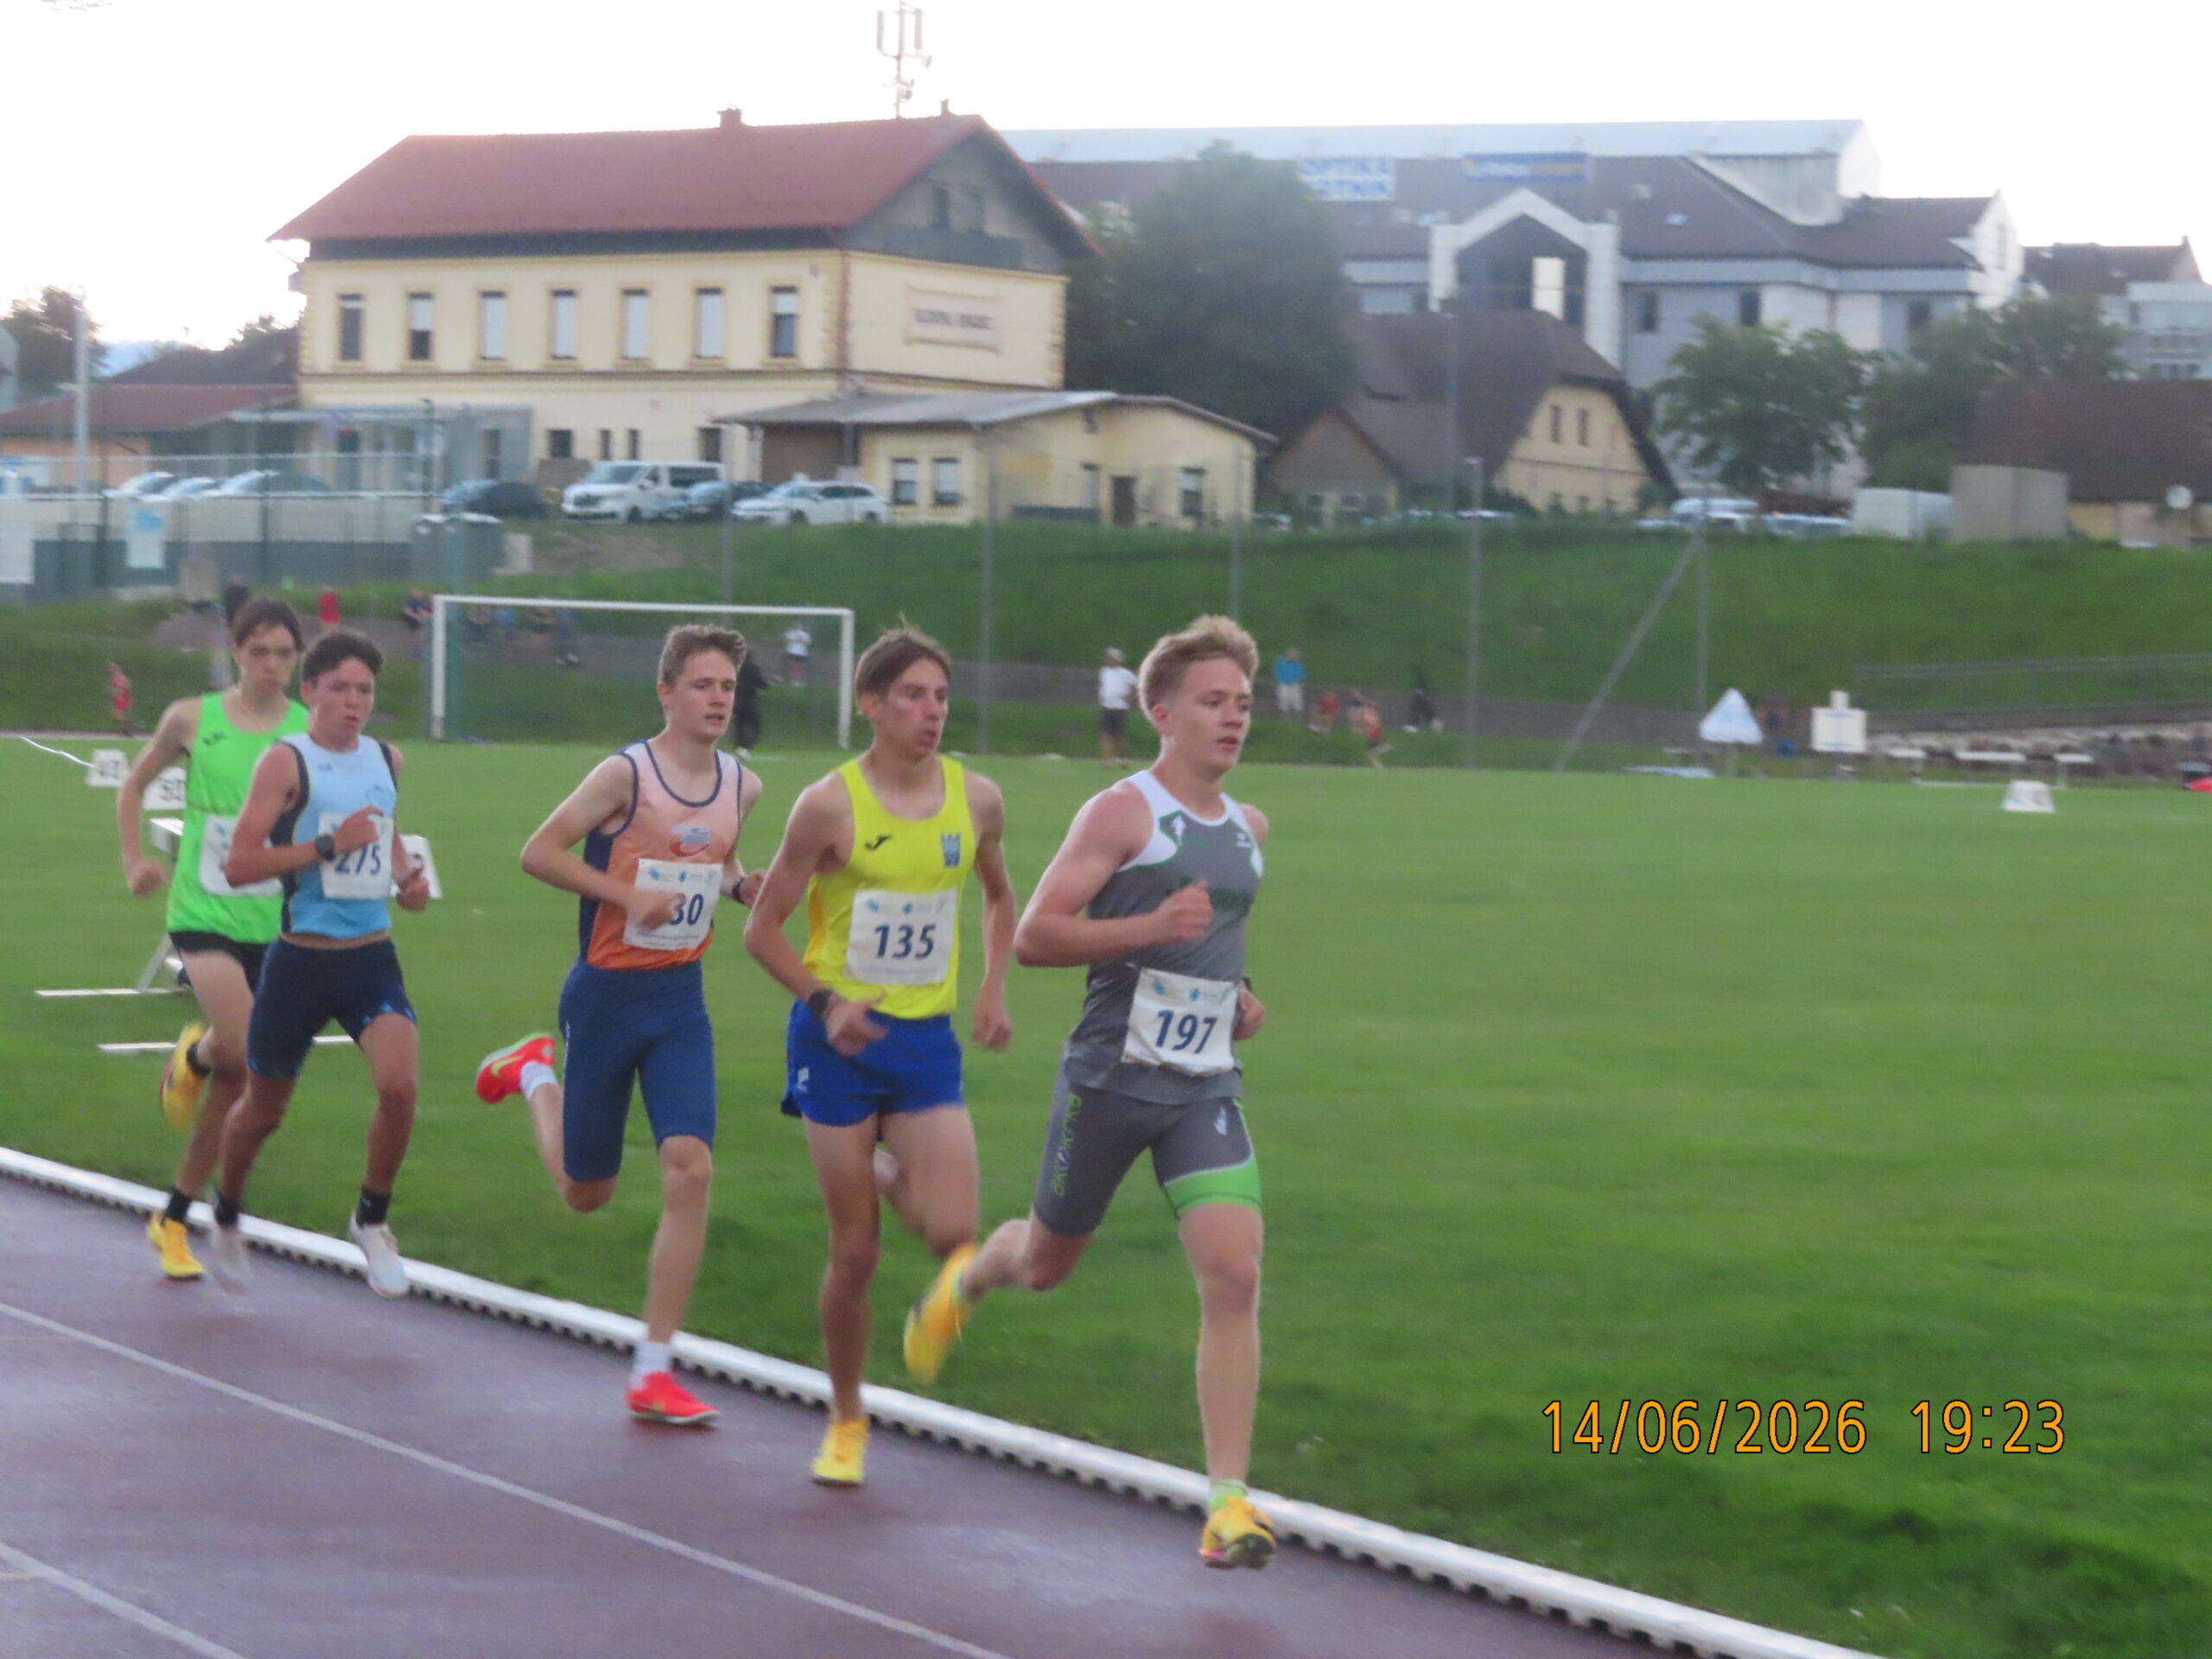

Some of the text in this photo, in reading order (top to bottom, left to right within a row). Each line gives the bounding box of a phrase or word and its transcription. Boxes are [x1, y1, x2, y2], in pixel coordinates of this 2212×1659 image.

[334, 843, 382, 875] 275
[665, 893, 705, 926] 30
[874, 922, 938, 960] 135
[1154, 1008, 1218, 1054] 197
